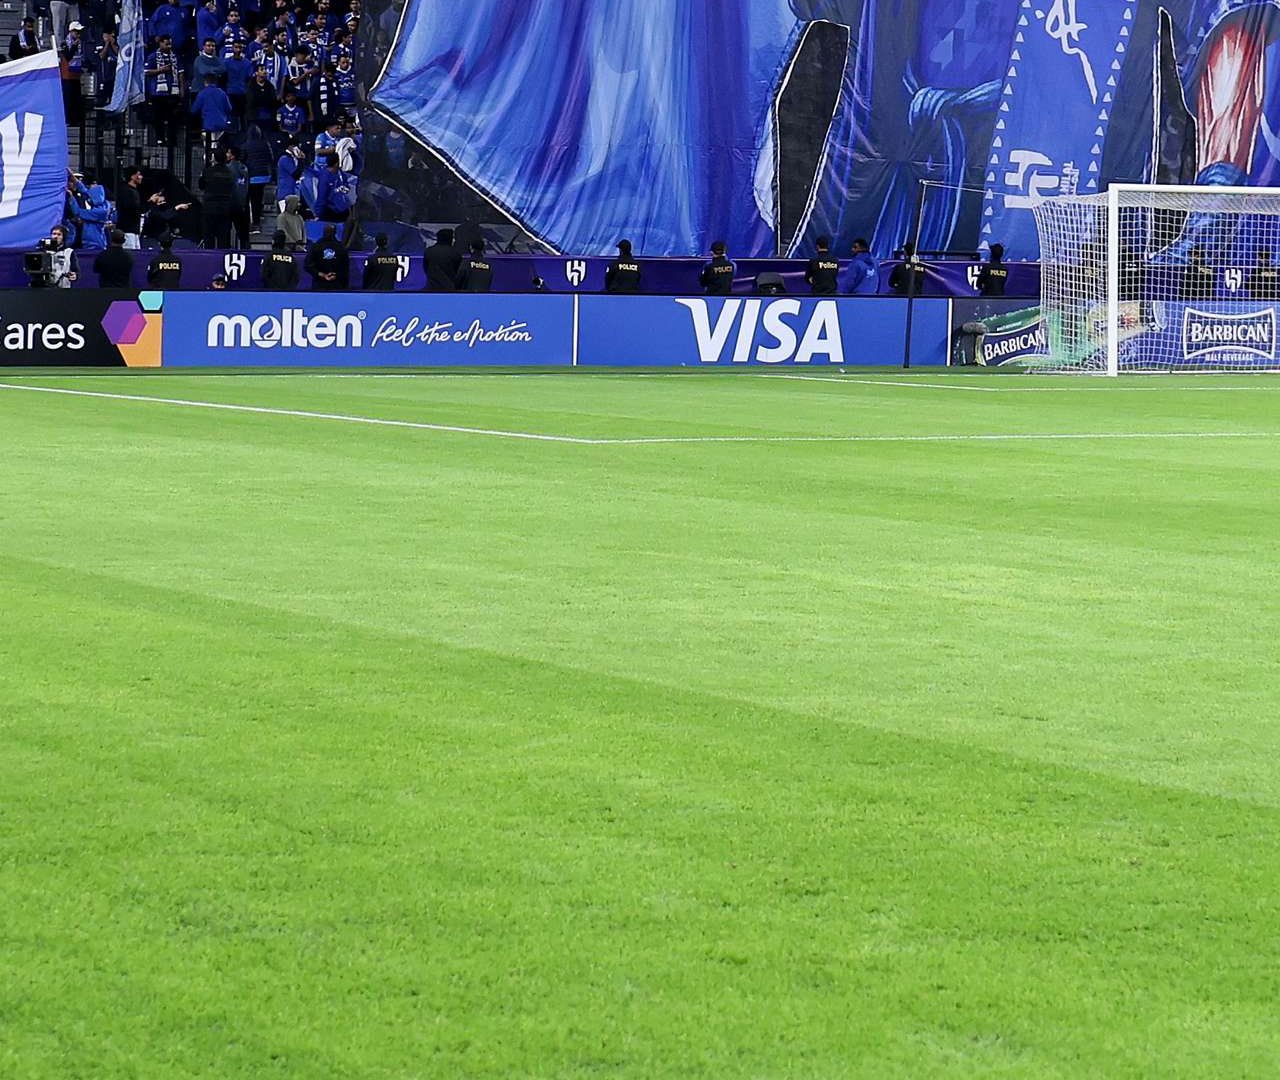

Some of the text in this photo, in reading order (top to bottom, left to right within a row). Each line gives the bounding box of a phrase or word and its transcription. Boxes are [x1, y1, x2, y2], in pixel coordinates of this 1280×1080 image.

[272, 254, 293, 263] POLICE
[377, 257, 397, 265] POLICE
[159, 262, 180, 270] POLICE
[470, 261, 490, 269] Police
[618, 263, 638, 271] POLICE
[818, 261, 838, 270] Police
[371, 316, 418, 348] feel
[416, 323, 453, 344] the
[675, 298, 846, 363] VISA
[1191, 323, 1268, 342] BARBICAN
[984, 329, 1046, 361] BARBICAN
